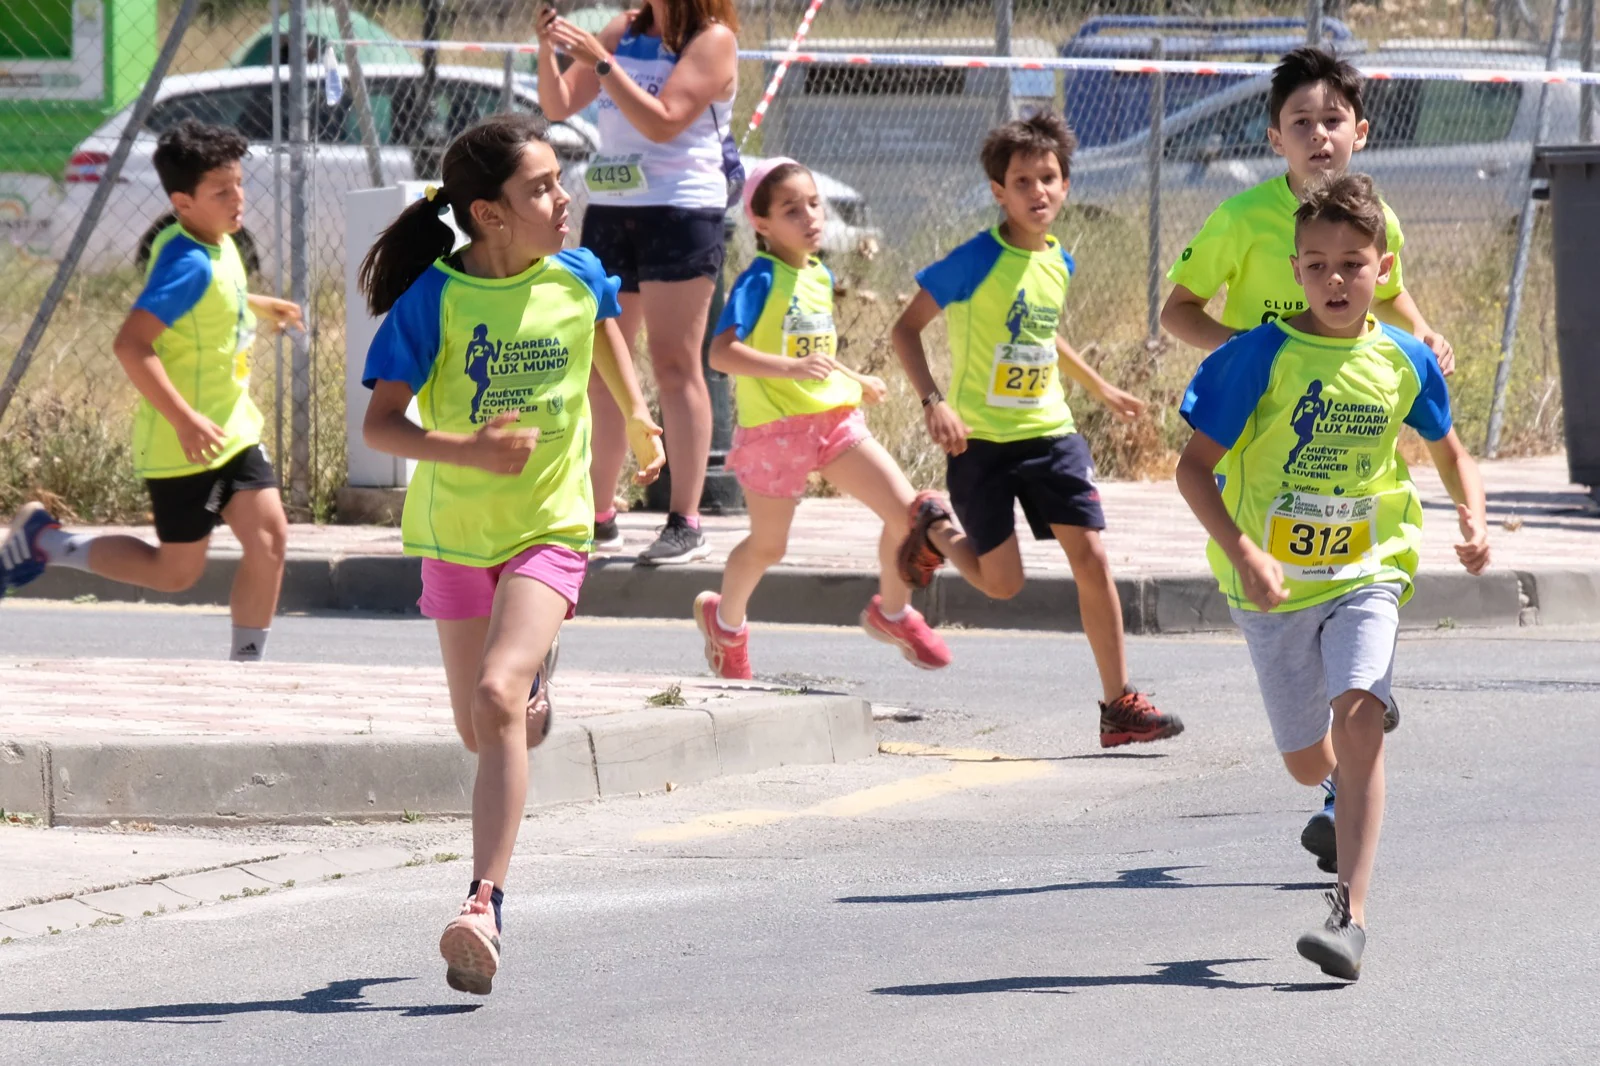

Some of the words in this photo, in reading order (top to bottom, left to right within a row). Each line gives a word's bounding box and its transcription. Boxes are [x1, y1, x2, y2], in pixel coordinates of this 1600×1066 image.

[592, 165, 631, 184] 449
[1264, 299, 1304, 311] CLUB
[505, 337, 560, 351] CARRERA
[502, 347, 569, 362] SOLIDARIA
[490, 364, 519, 375] LUX
[523, 357, 568, 373] MUNDI
[487, 388, 534, 398] MUÉVETE
[482, 398, 526, 407] CONTRA
[482, 407, 494, 415] EL
[497, 405, 538, 415] CÁCER
[1334, 403, 1385, 414] CARRERA
[1330, 413, 1389, 424] SOLIDARIA
[1315, 422, 1342, 433] LUX
[1305, 446, 1349, 455] MUÉVETE
[1301, 454, 1337, 462] CONTRA
[1297, 461, 1308, 470] EL
[1310, 461, 1348, 472] CÁNCER
[1292, 468, 1331, 479] JUVENIL
[1289, 523, 1353, 556] 312
